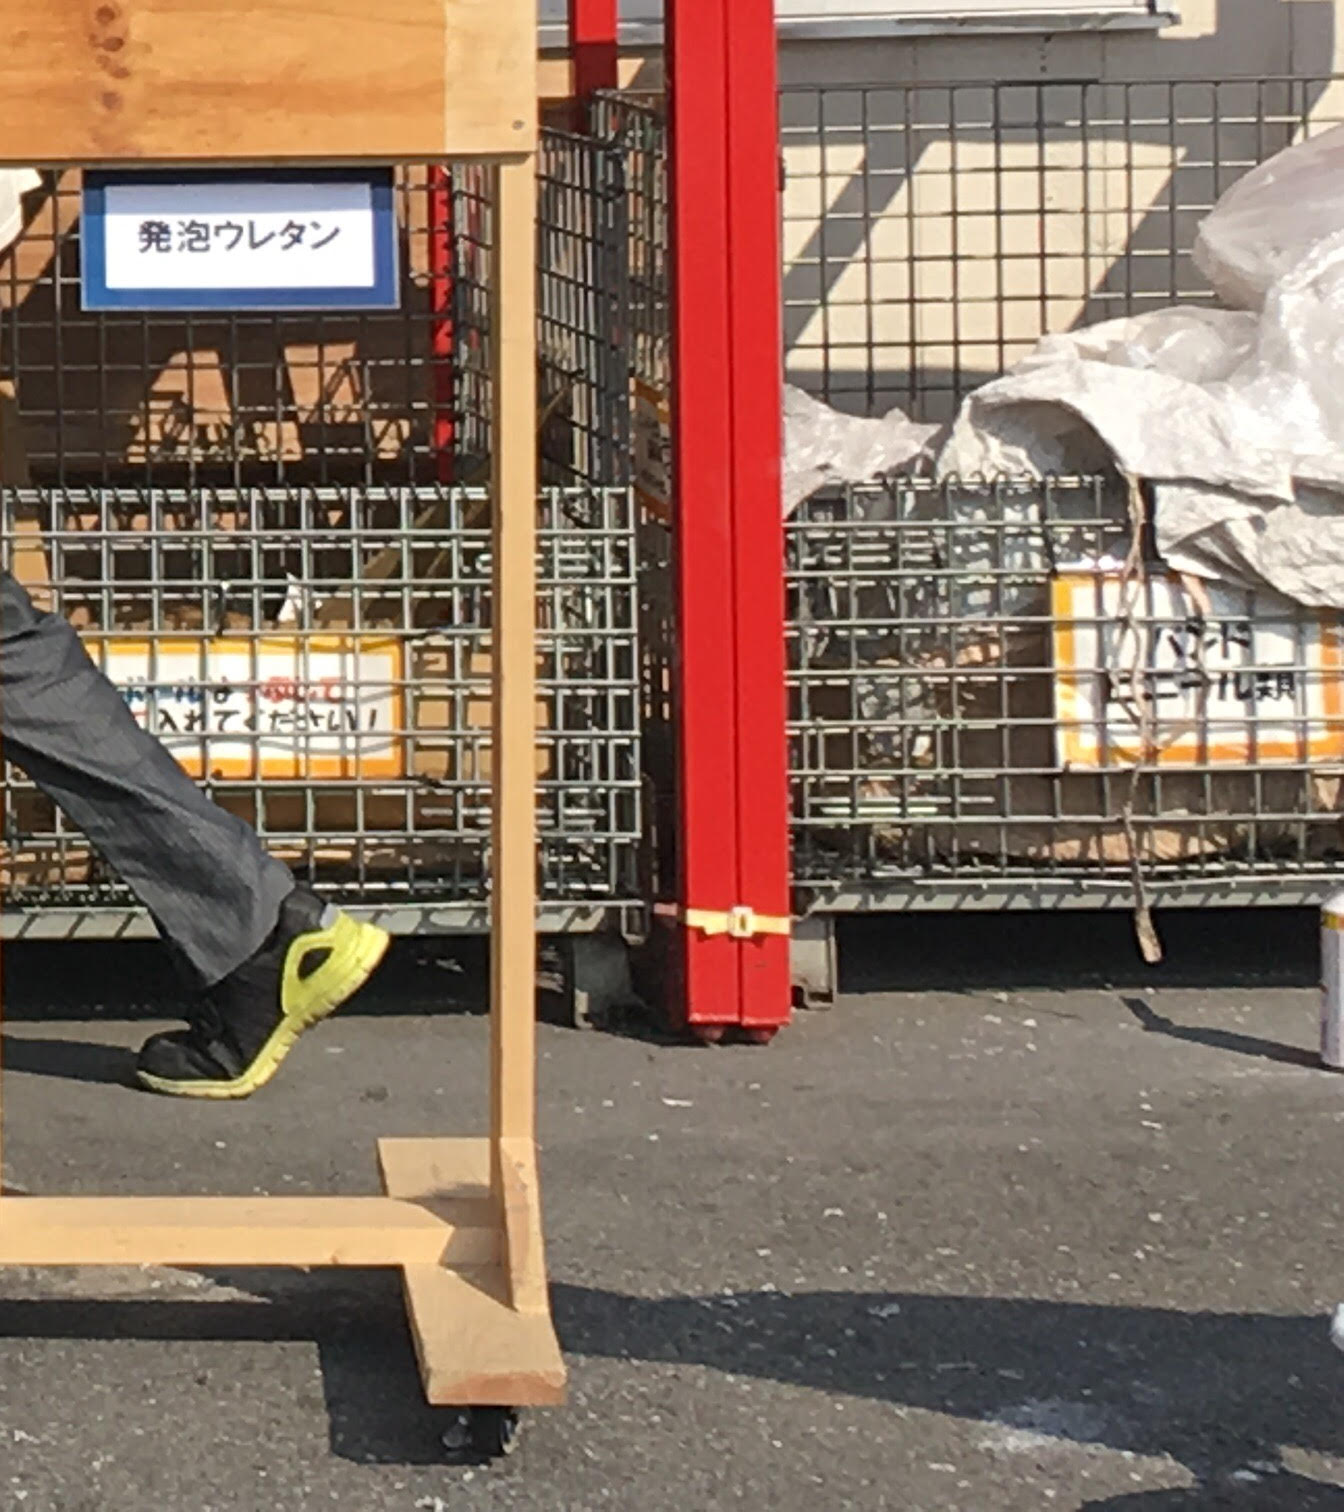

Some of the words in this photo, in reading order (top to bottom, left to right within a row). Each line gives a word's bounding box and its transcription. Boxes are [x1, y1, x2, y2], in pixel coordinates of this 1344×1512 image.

[138, 218, 340, 254] 発泡ウレタン
